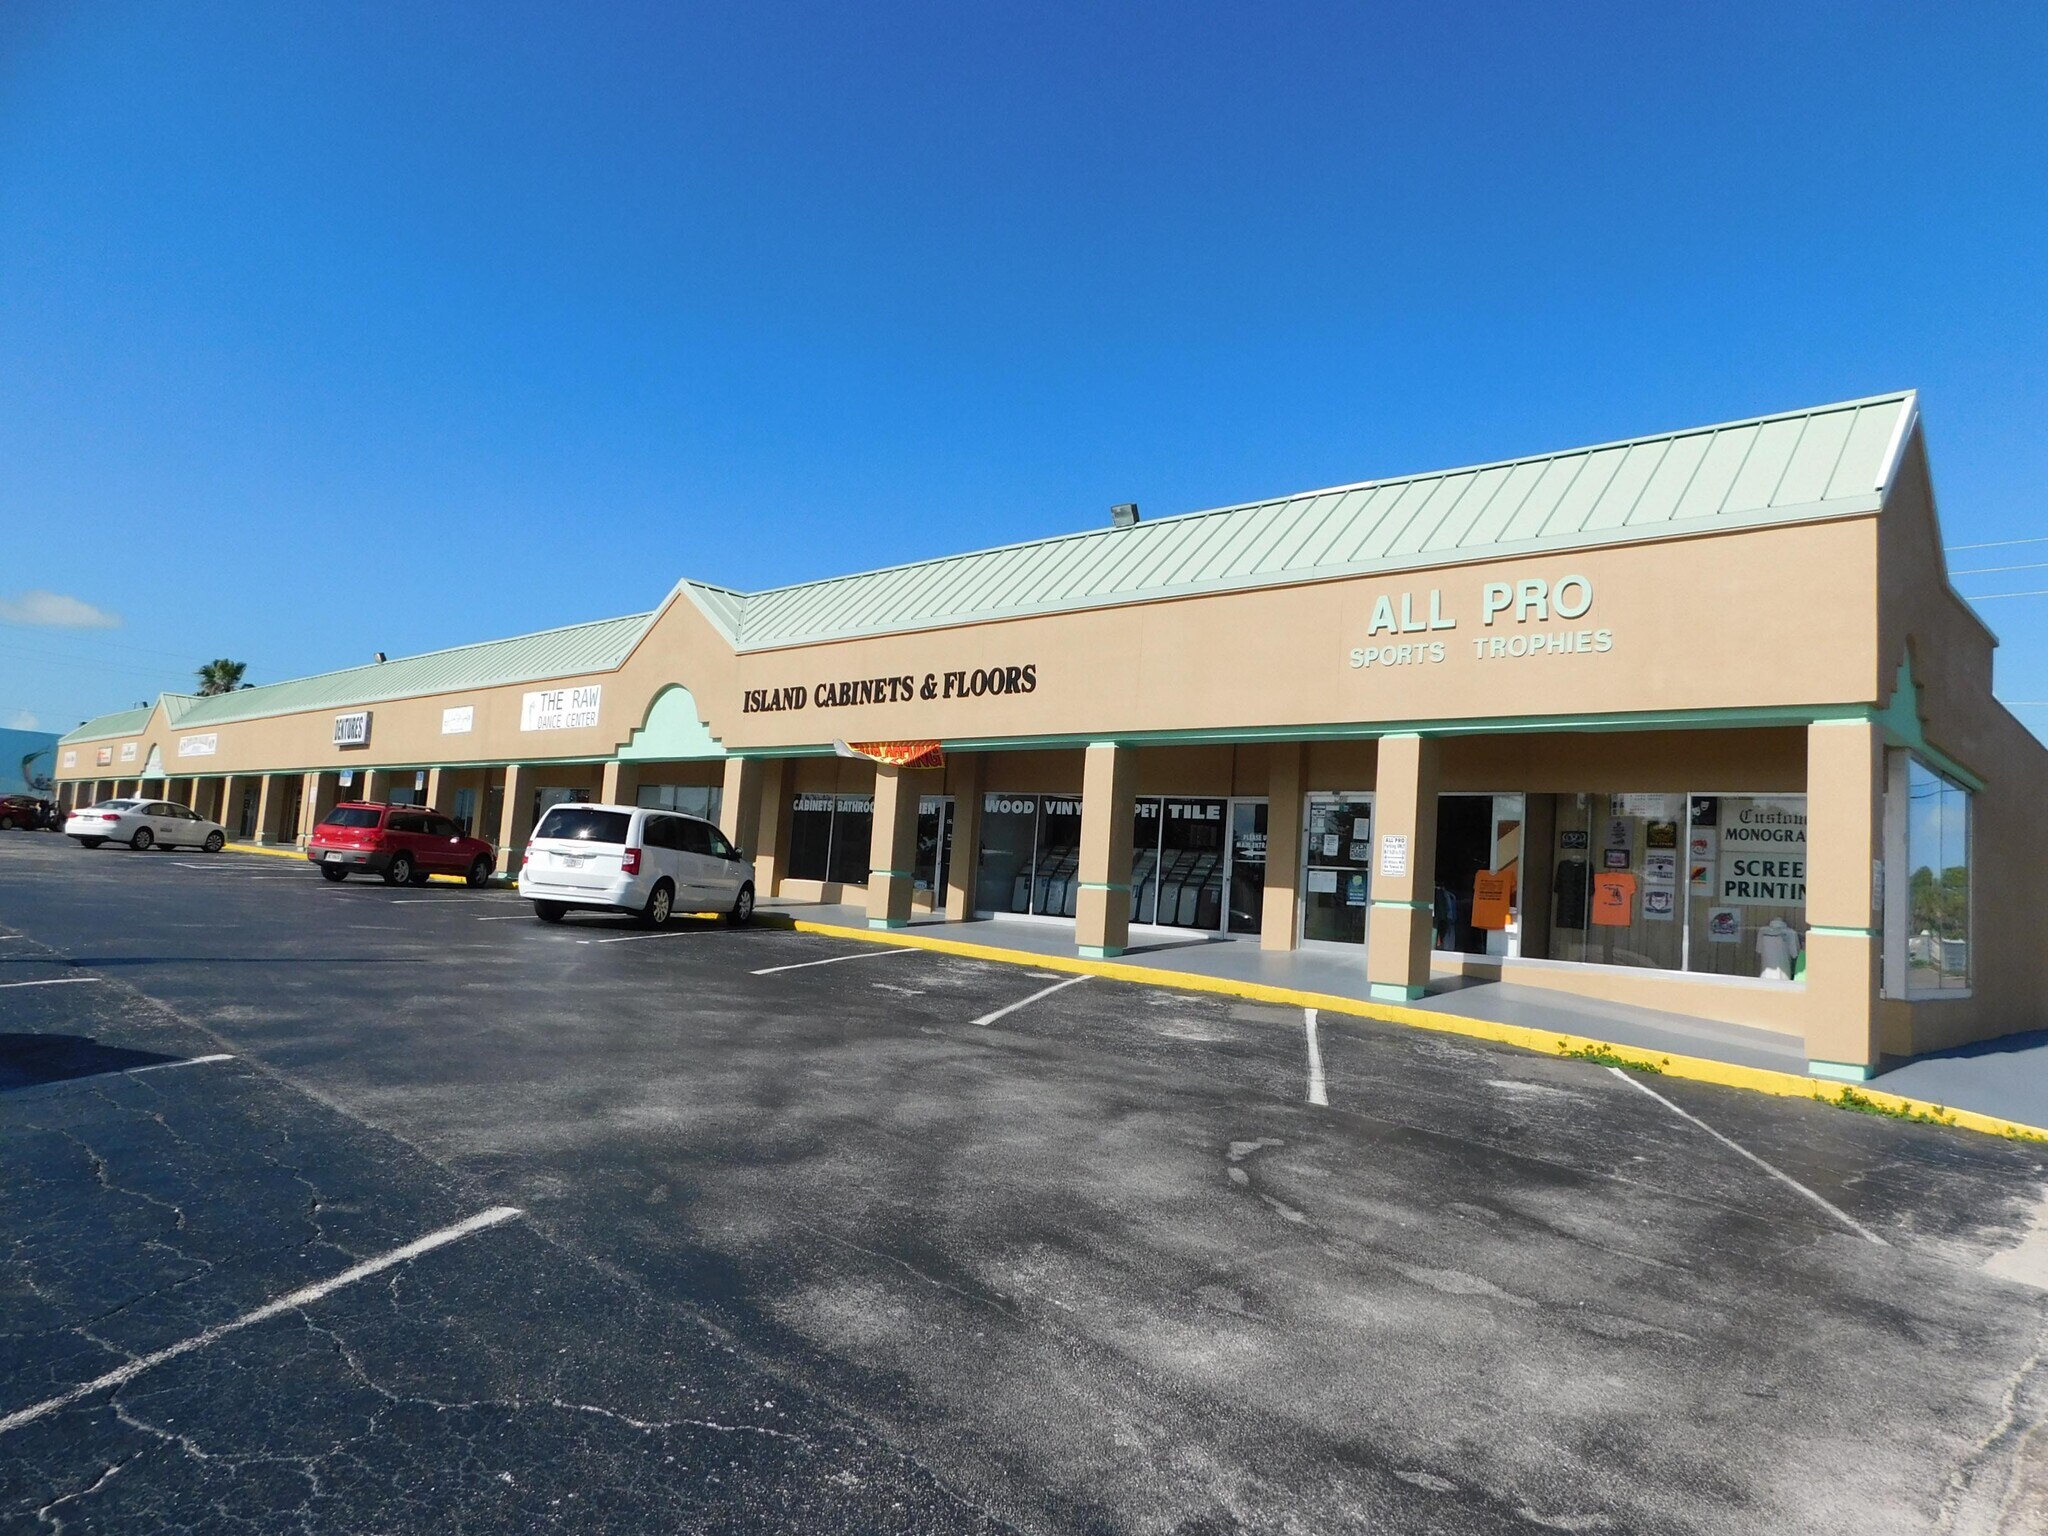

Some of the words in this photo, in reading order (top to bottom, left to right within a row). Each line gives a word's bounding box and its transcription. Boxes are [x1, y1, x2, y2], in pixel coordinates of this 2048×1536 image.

[1368, 589, 1456, 636] ALL
[1482, 574, 1593, 626] PRO
[1349, 641, 1446, 668] SPORTS
[1473, 628, 1613, 659] TROPHIES
[743, 685, 807, 713] ISLAND
[814, 675, 914, 708] CABINETS
[920, 673, 938, 699] &
[942, 664, 1037, 698] FLOORS
[541, 692, 564, 711] THE
[572, 687, 599, 709] RAW
[334, 716, 364, 740] DENTURES
[538, 714, 562, 729] DANCE
[566, 711, 596, 727] CENTER
[793, 799, 832, 813] CABINETS
[985, 800, 1034, 814] WOOD
[1044, 801, 1083, 815] VINY
[1168, 804, 1220, 819] TILE
[1725, 828, 1806, 843] MONOGRA
[1733, 860, 1804, 878] SCREE
[1724, 880, 1807, 900] PRINTIN
